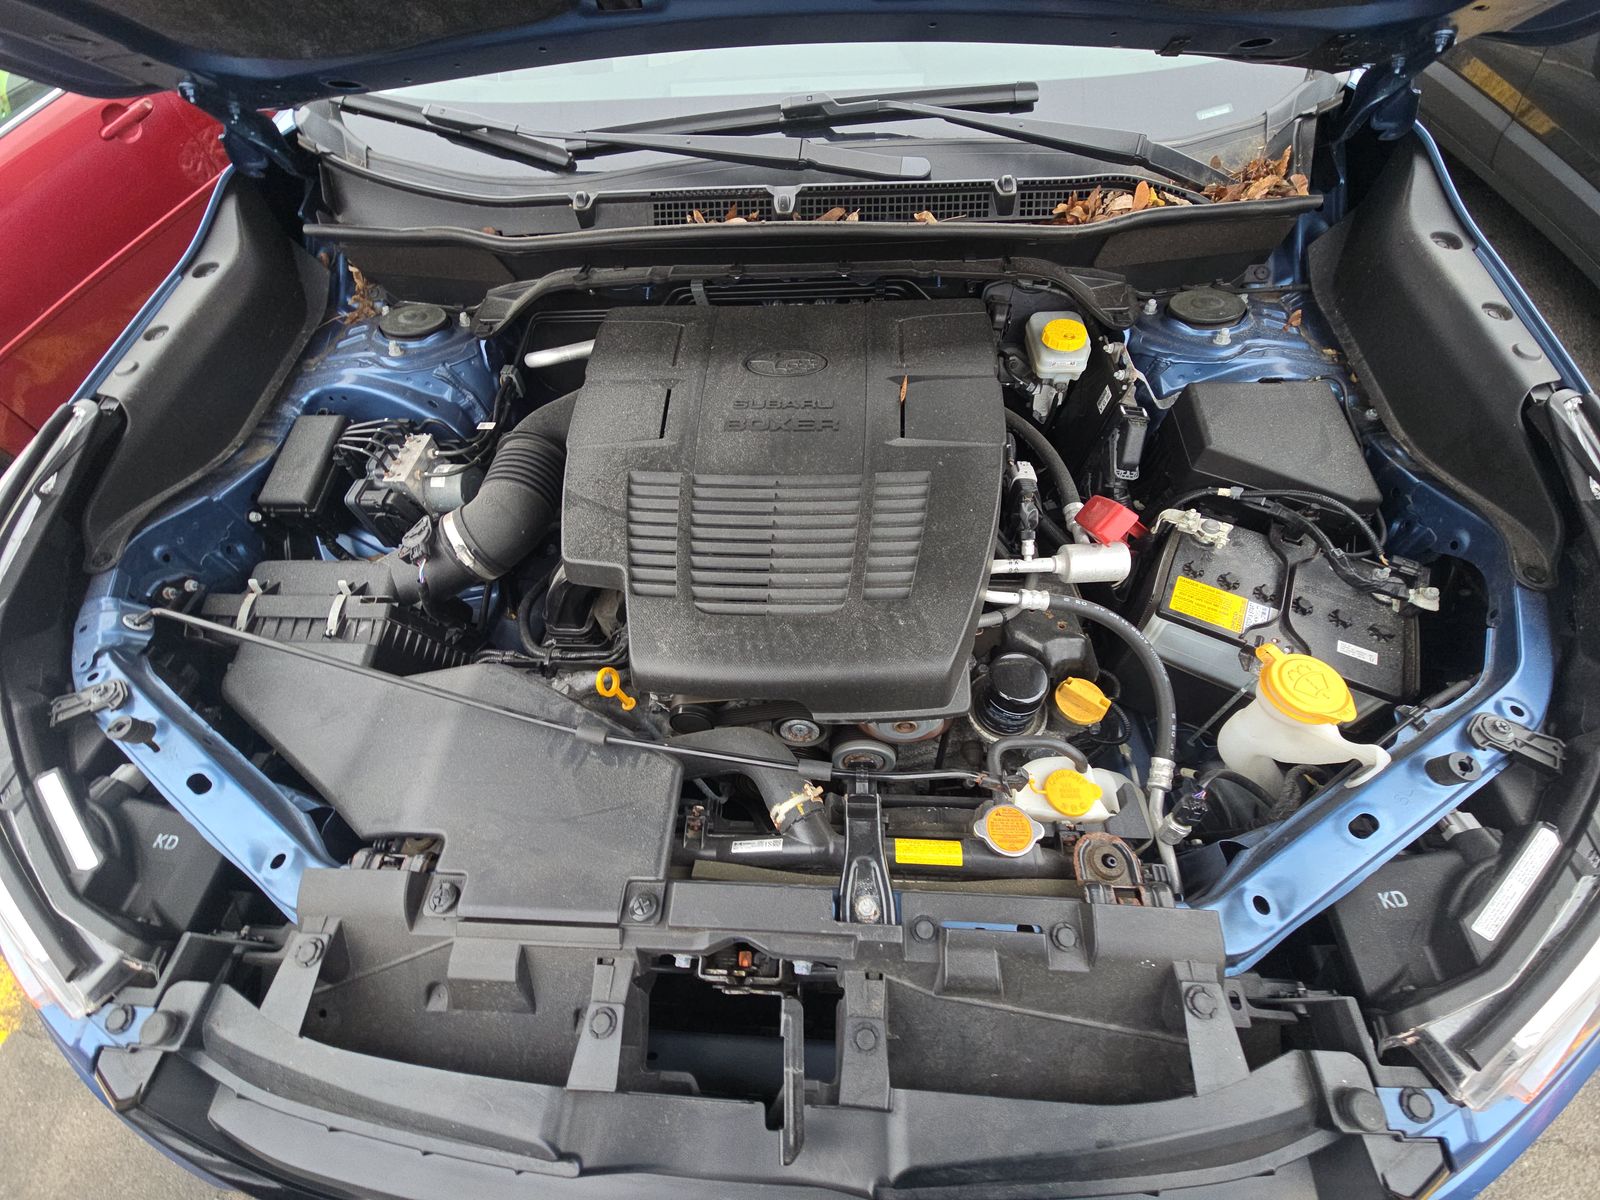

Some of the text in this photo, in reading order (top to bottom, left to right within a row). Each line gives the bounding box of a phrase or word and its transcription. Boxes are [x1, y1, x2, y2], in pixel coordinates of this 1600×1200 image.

[732, 399, 834, 410] SUBARU
[724, 418, 840, 432] BOXER
[152, 832, 179, 850] KD
[1377, 890, 1409, 910] KD
